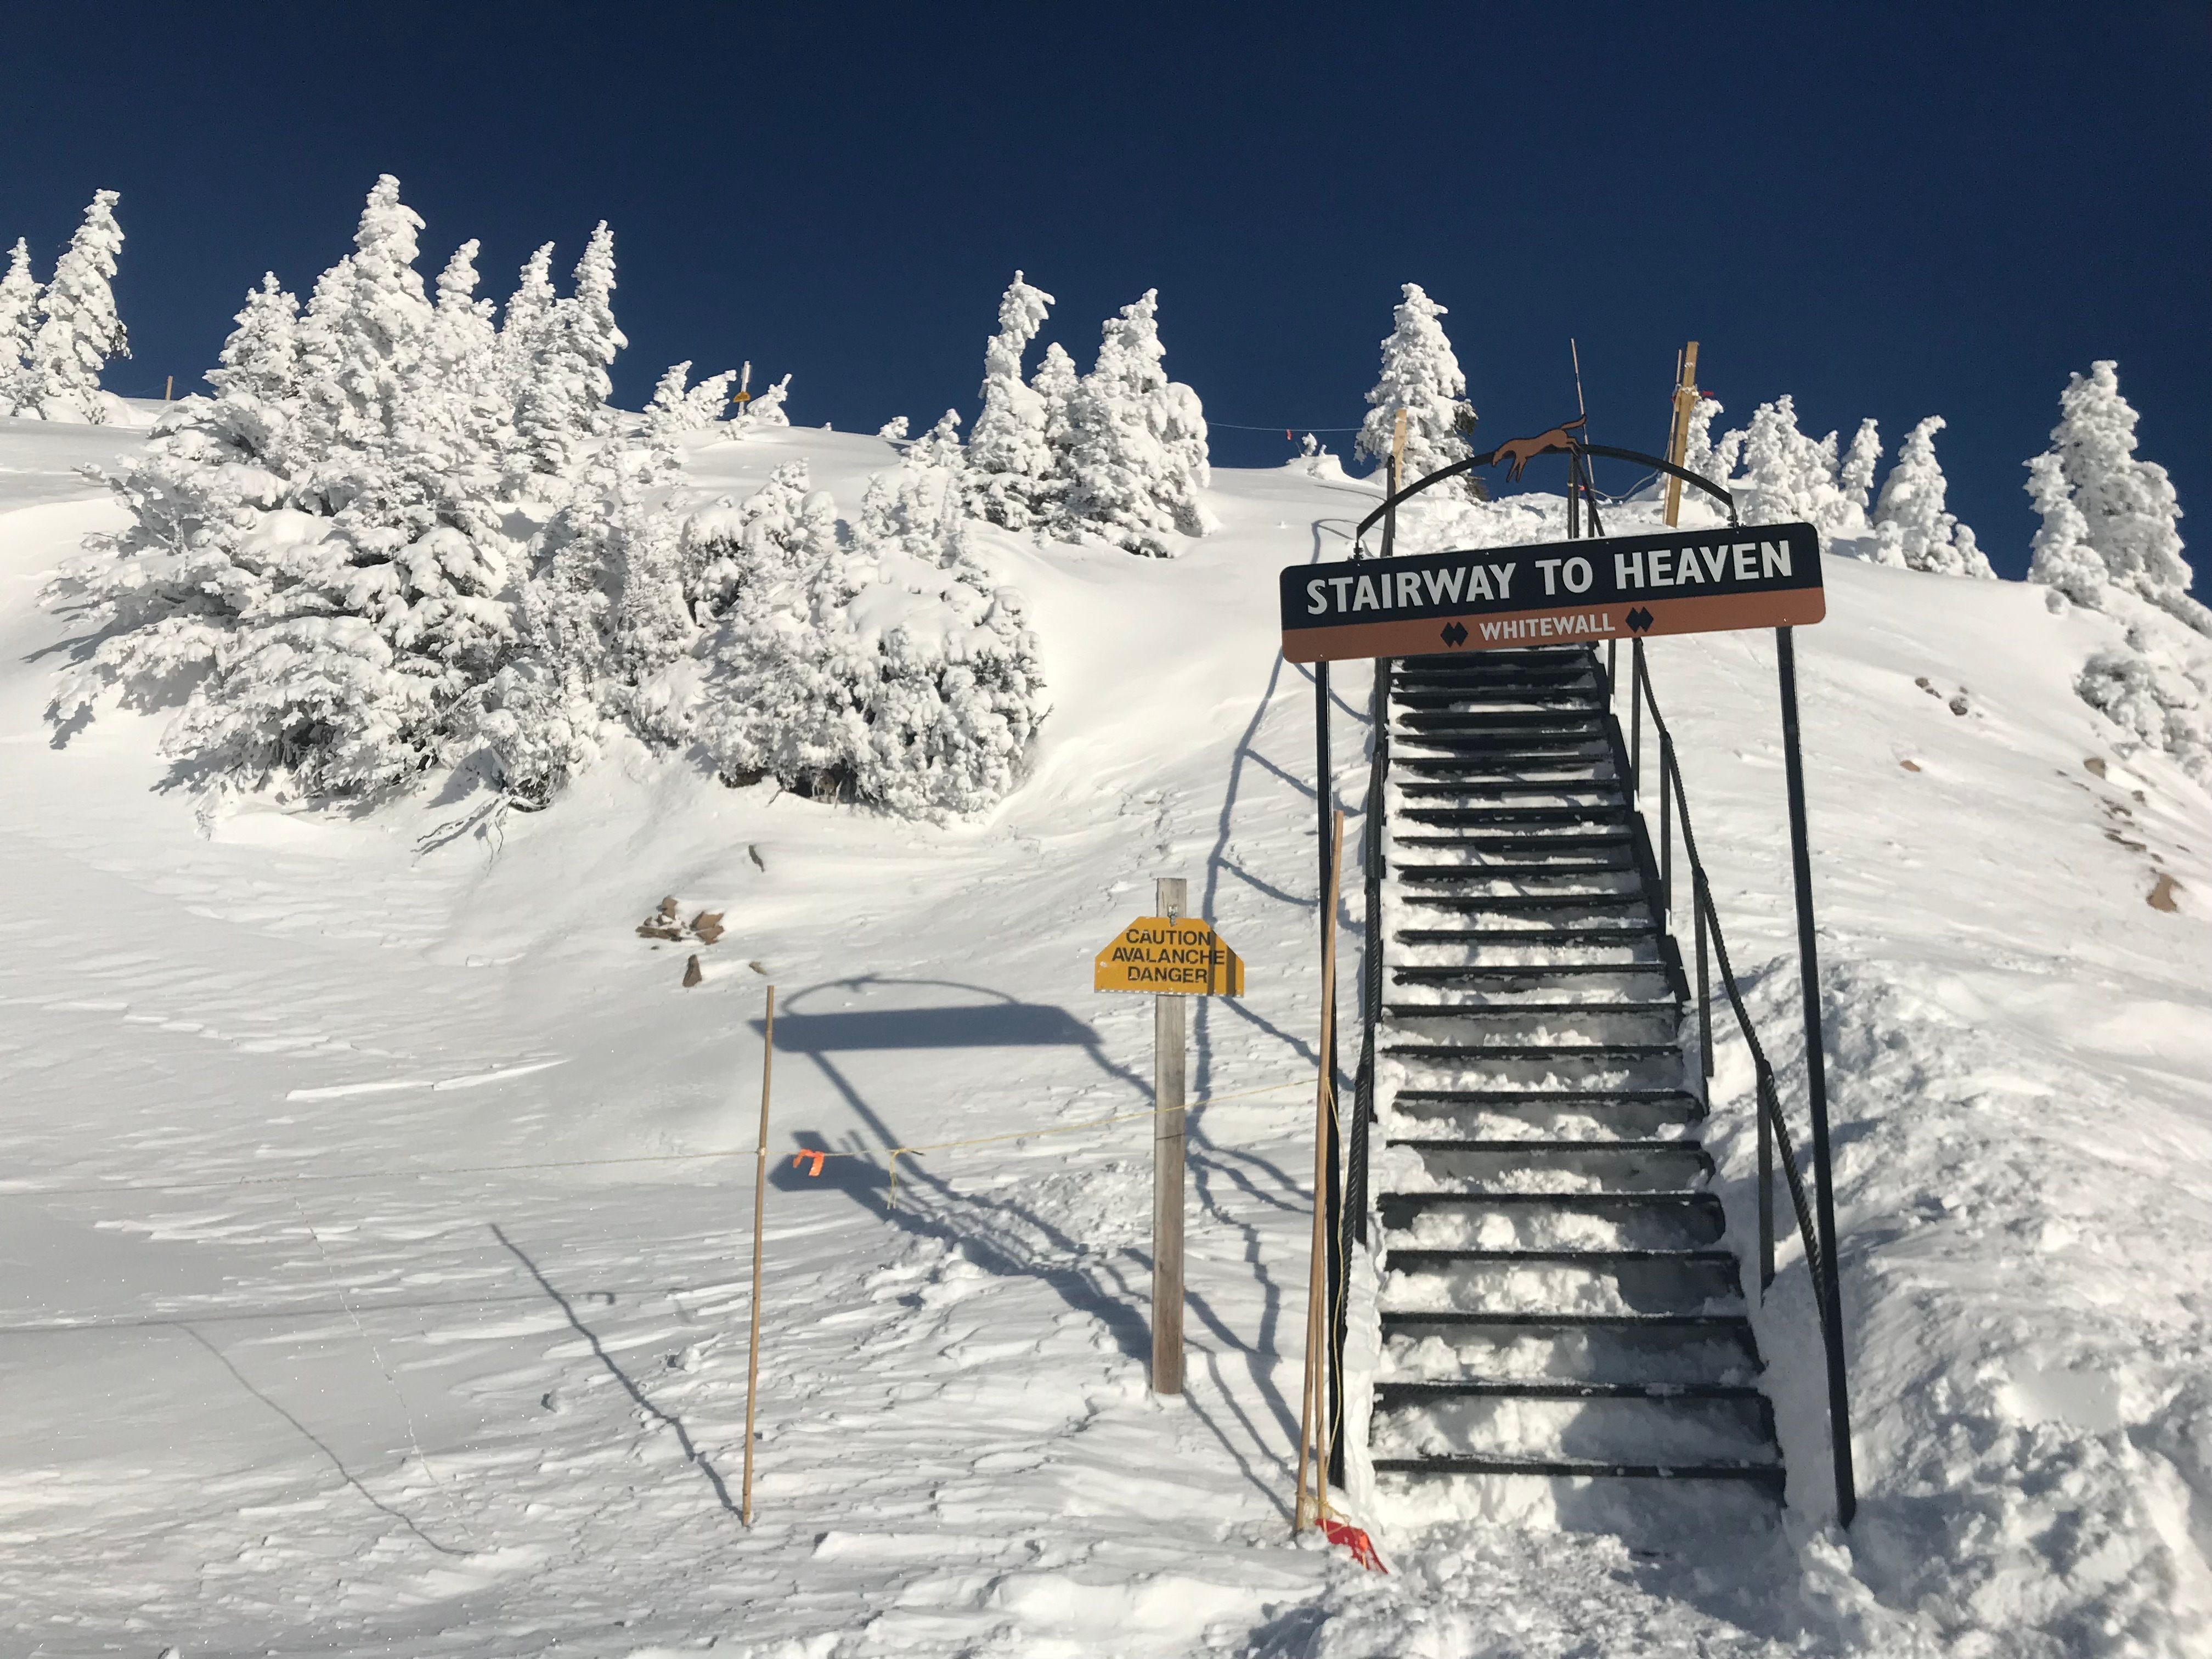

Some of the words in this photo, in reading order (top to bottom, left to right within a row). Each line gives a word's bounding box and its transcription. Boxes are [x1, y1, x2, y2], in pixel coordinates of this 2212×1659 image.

[1306, 562, 1516, 615] STAIRWAY
[1535, 557, 1593, 595] TO
[1614, 539, 1792, 590] HEAVEN
[1479, 612, 1615, 641] WHITEWALL
[1126, 929, 1211, 946] CAUTION
[1111, 947, 1225, 965] AVALANCHE
[1127, 966, 1207, 984] DANGER
